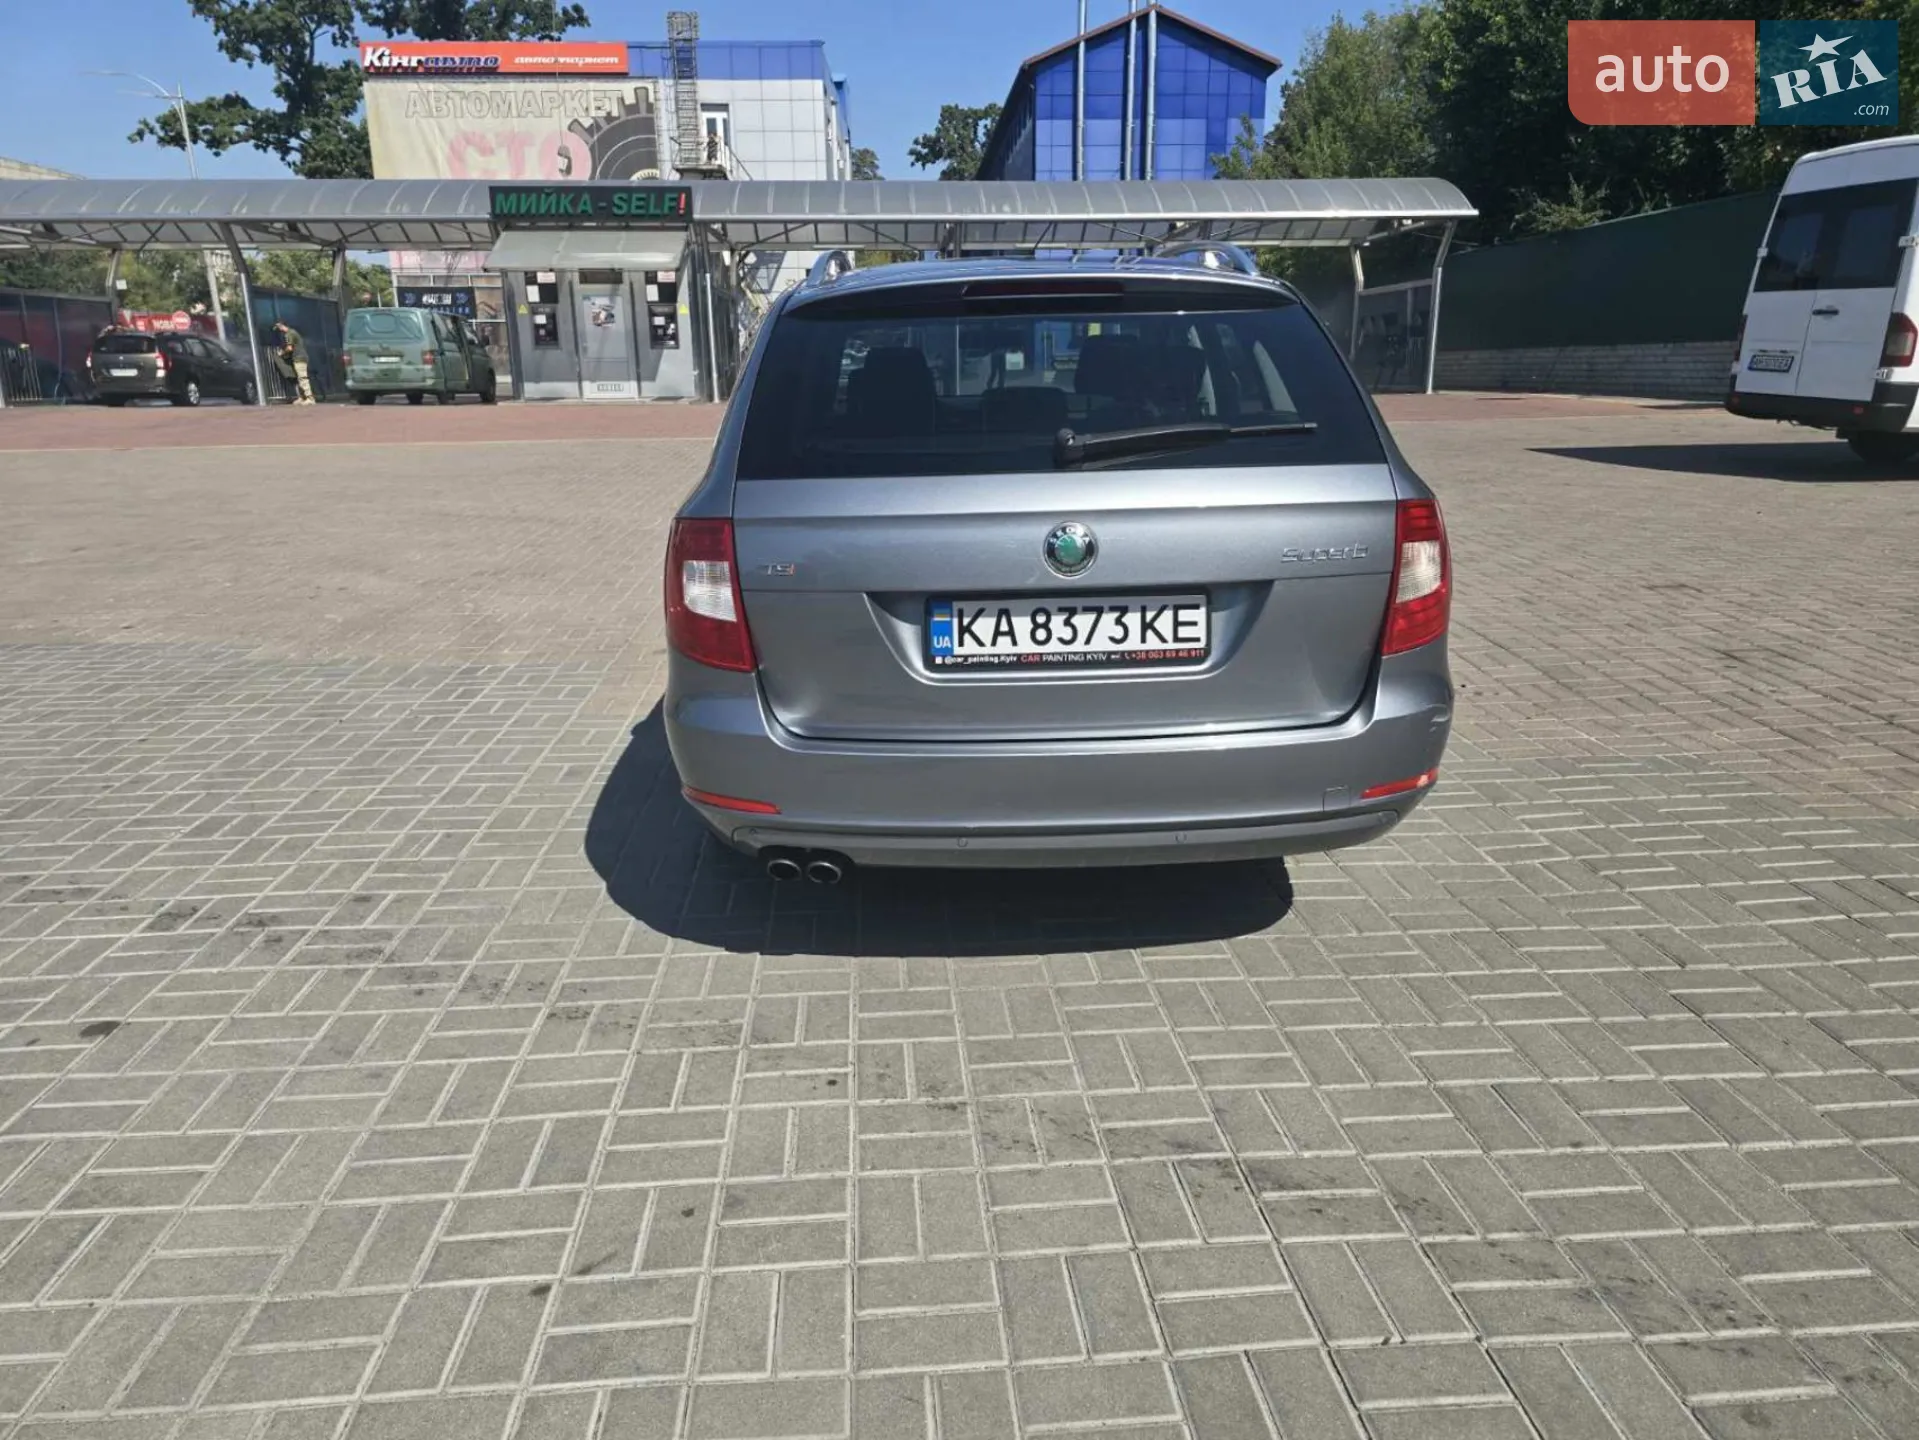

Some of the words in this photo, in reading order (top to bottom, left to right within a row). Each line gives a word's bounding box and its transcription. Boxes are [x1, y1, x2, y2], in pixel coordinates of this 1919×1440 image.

[405, 88, 623, 118] АВТОМАРКЕТ
[494, 188, 592, 215] МИЙКА
[1281, 544, 1369, 563] Superb
[957, 607, 1018, 648] KA
[1029, 605, 1130, 646] 8373
[1140, 603, 1202, 644] KE
[933, 636, 951, 648] UA
[1021, 654, 1040, 663] CAR
[1042, 653, 1084, 662] PAINTING
[1086, 652, 1107, 661] KYIV
